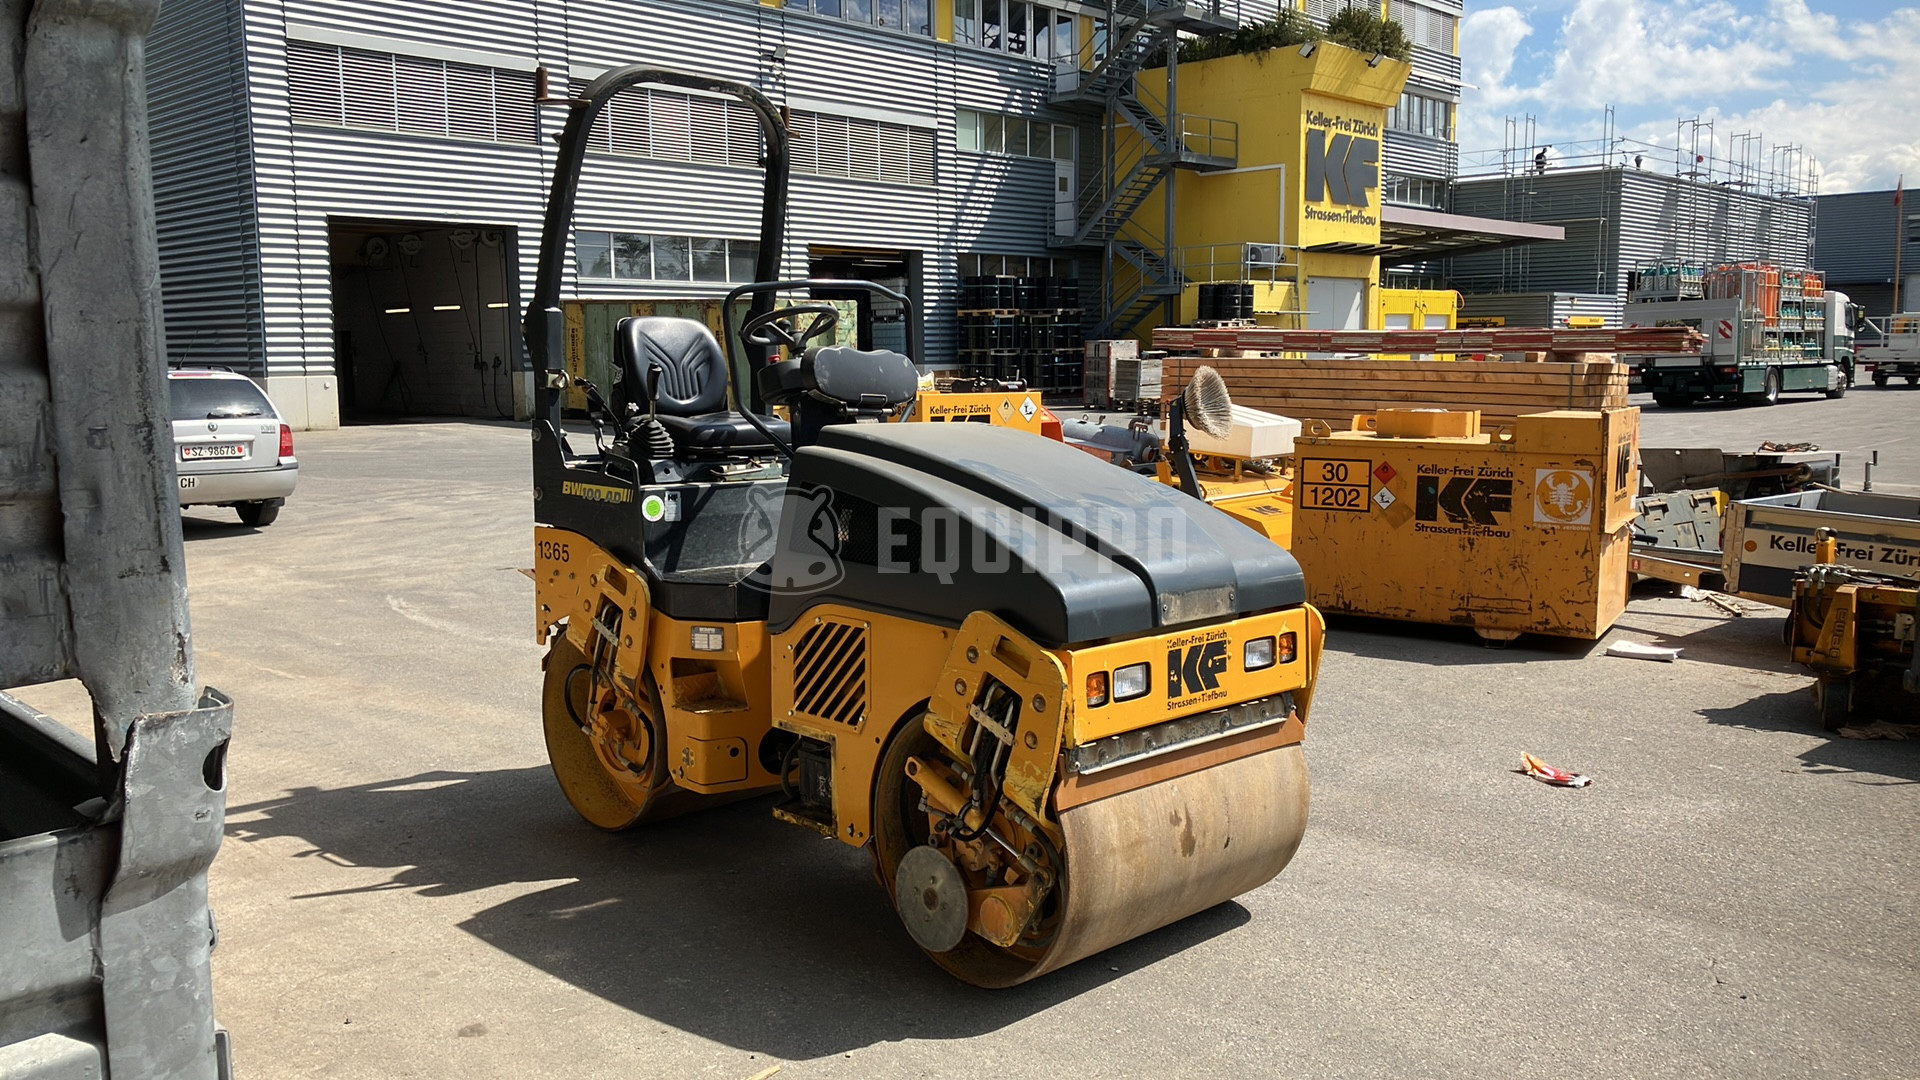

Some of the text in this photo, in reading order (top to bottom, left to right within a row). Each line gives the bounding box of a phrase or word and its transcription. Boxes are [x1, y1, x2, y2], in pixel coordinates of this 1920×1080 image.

[1306, 109, 1378, 138] Keller-Frei Zürich
[1304, 127, 1379, 208] KF
[929, 403, 992, 415] Keller-Frei Zürich
[191, 445, 237, 457] SZ 98678
[1321, 462, 1349, 483] 30
[1416, 464, 1514, 478] Keller-Frei Zürich
[180, 477, 195, 488] CH
[1309, 487, 1361, 508] 1202
[1415, 475, 1514, 526] KF
[537, 540, 570, 563] 1365
[1205, 629, 1228, 642] Zürich
[1167, 639, 1228, 700] KF
